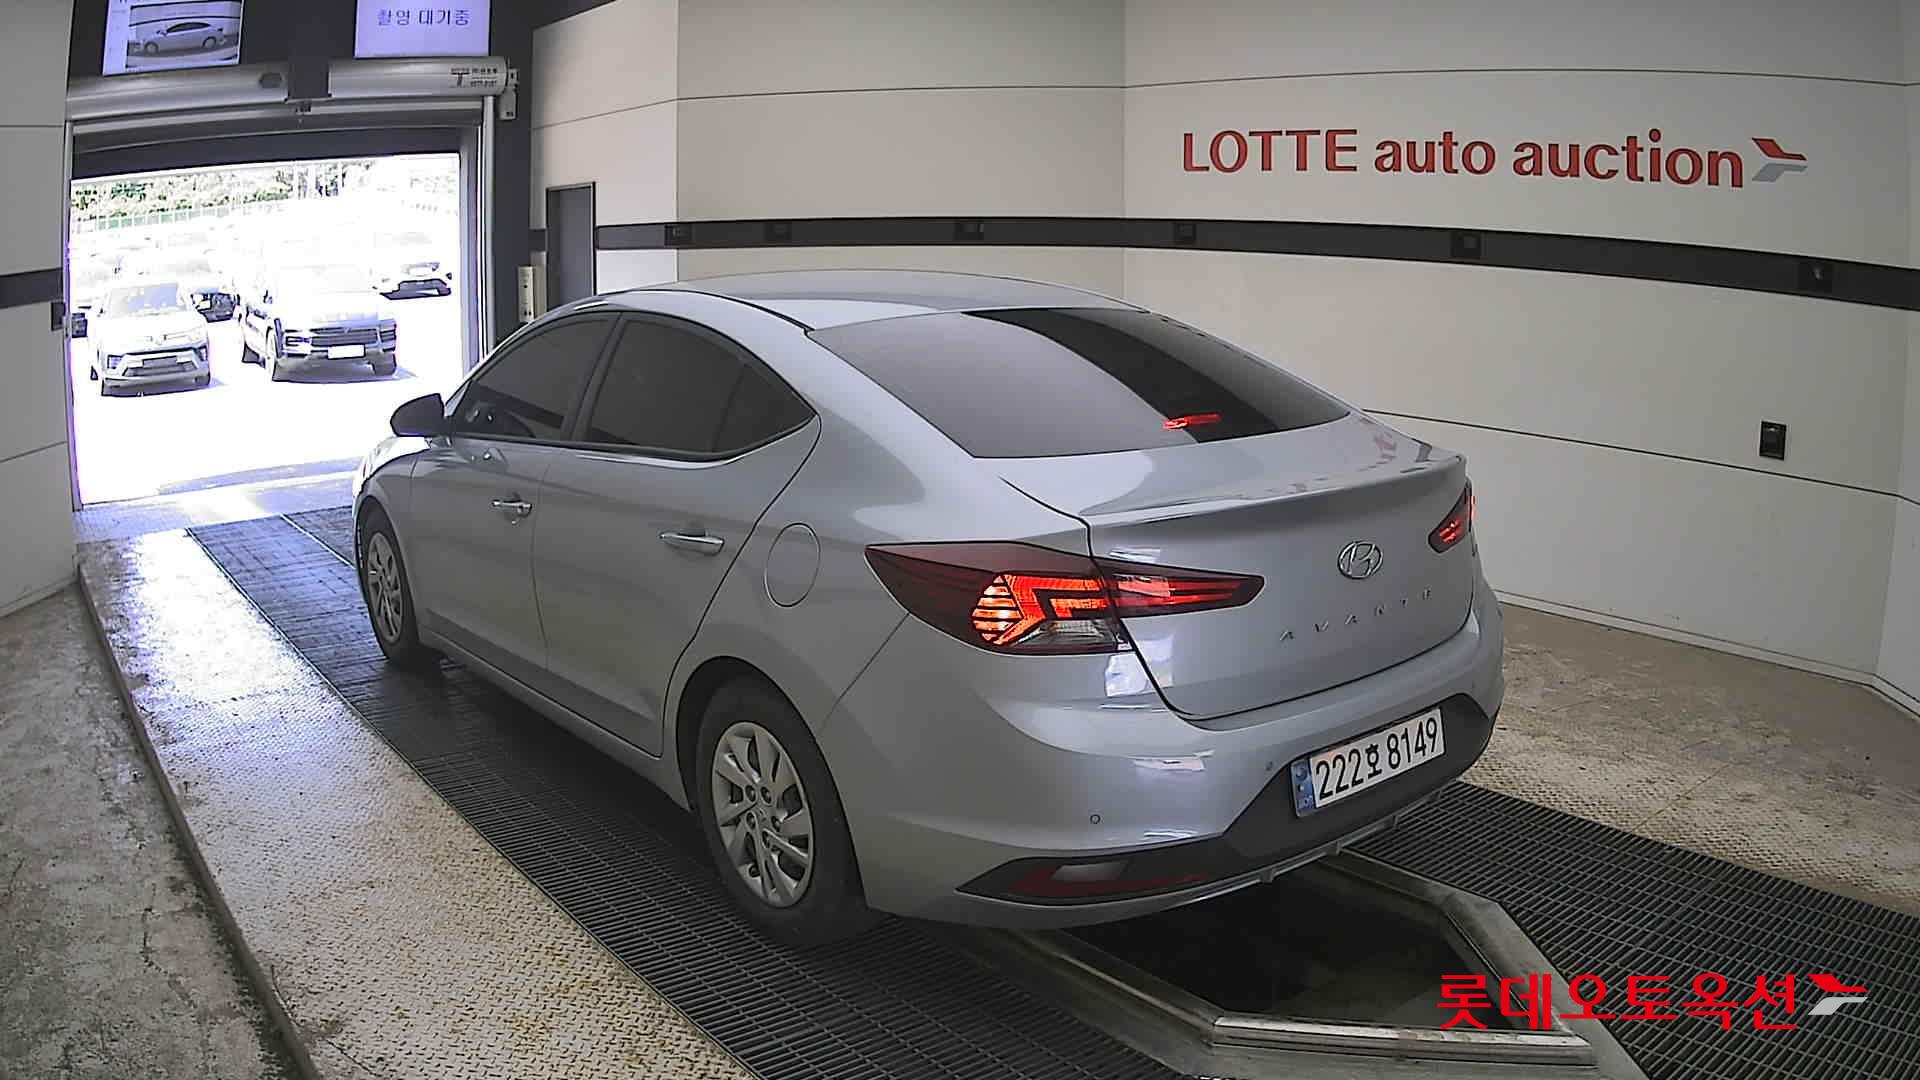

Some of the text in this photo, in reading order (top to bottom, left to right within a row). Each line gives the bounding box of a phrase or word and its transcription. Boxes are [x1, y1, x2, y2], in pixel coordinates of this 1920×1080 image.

[418, 9, 470, 26] 대기중
[1183, 128, 1744, 188] LOTTE auto auction
[1279, 588, 1433, 641] AVANTE
[1316, 717, 1438, 801] 222호 8149
